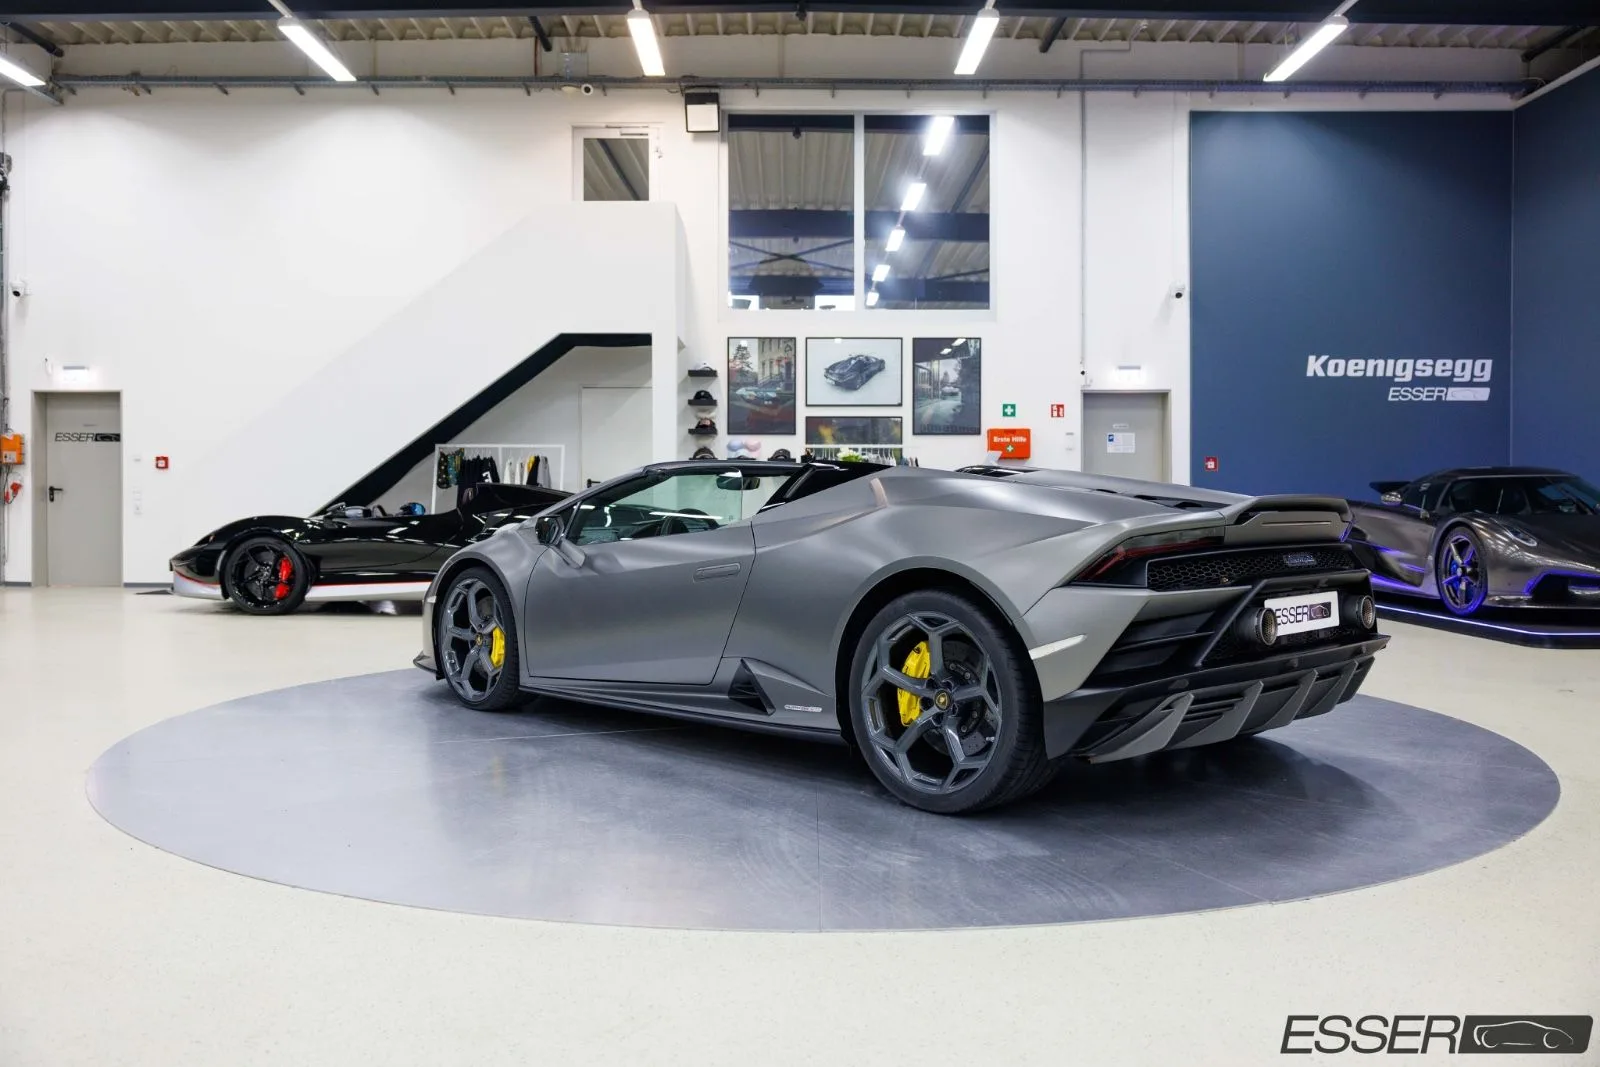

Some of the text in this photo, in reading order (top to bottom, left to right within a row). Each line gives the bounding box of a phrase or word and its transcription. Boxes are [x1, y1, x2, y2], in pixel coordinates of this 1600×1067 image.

[1306, 355, 1494, 382] Koenigsegg
[1388, 387, 1447, 401] ESSER
[55, 432, 95, 442] ESSER
[993, 435, 1027, 443] Erste Hilfe
[1274, 604, 1309, 626] ESSER
